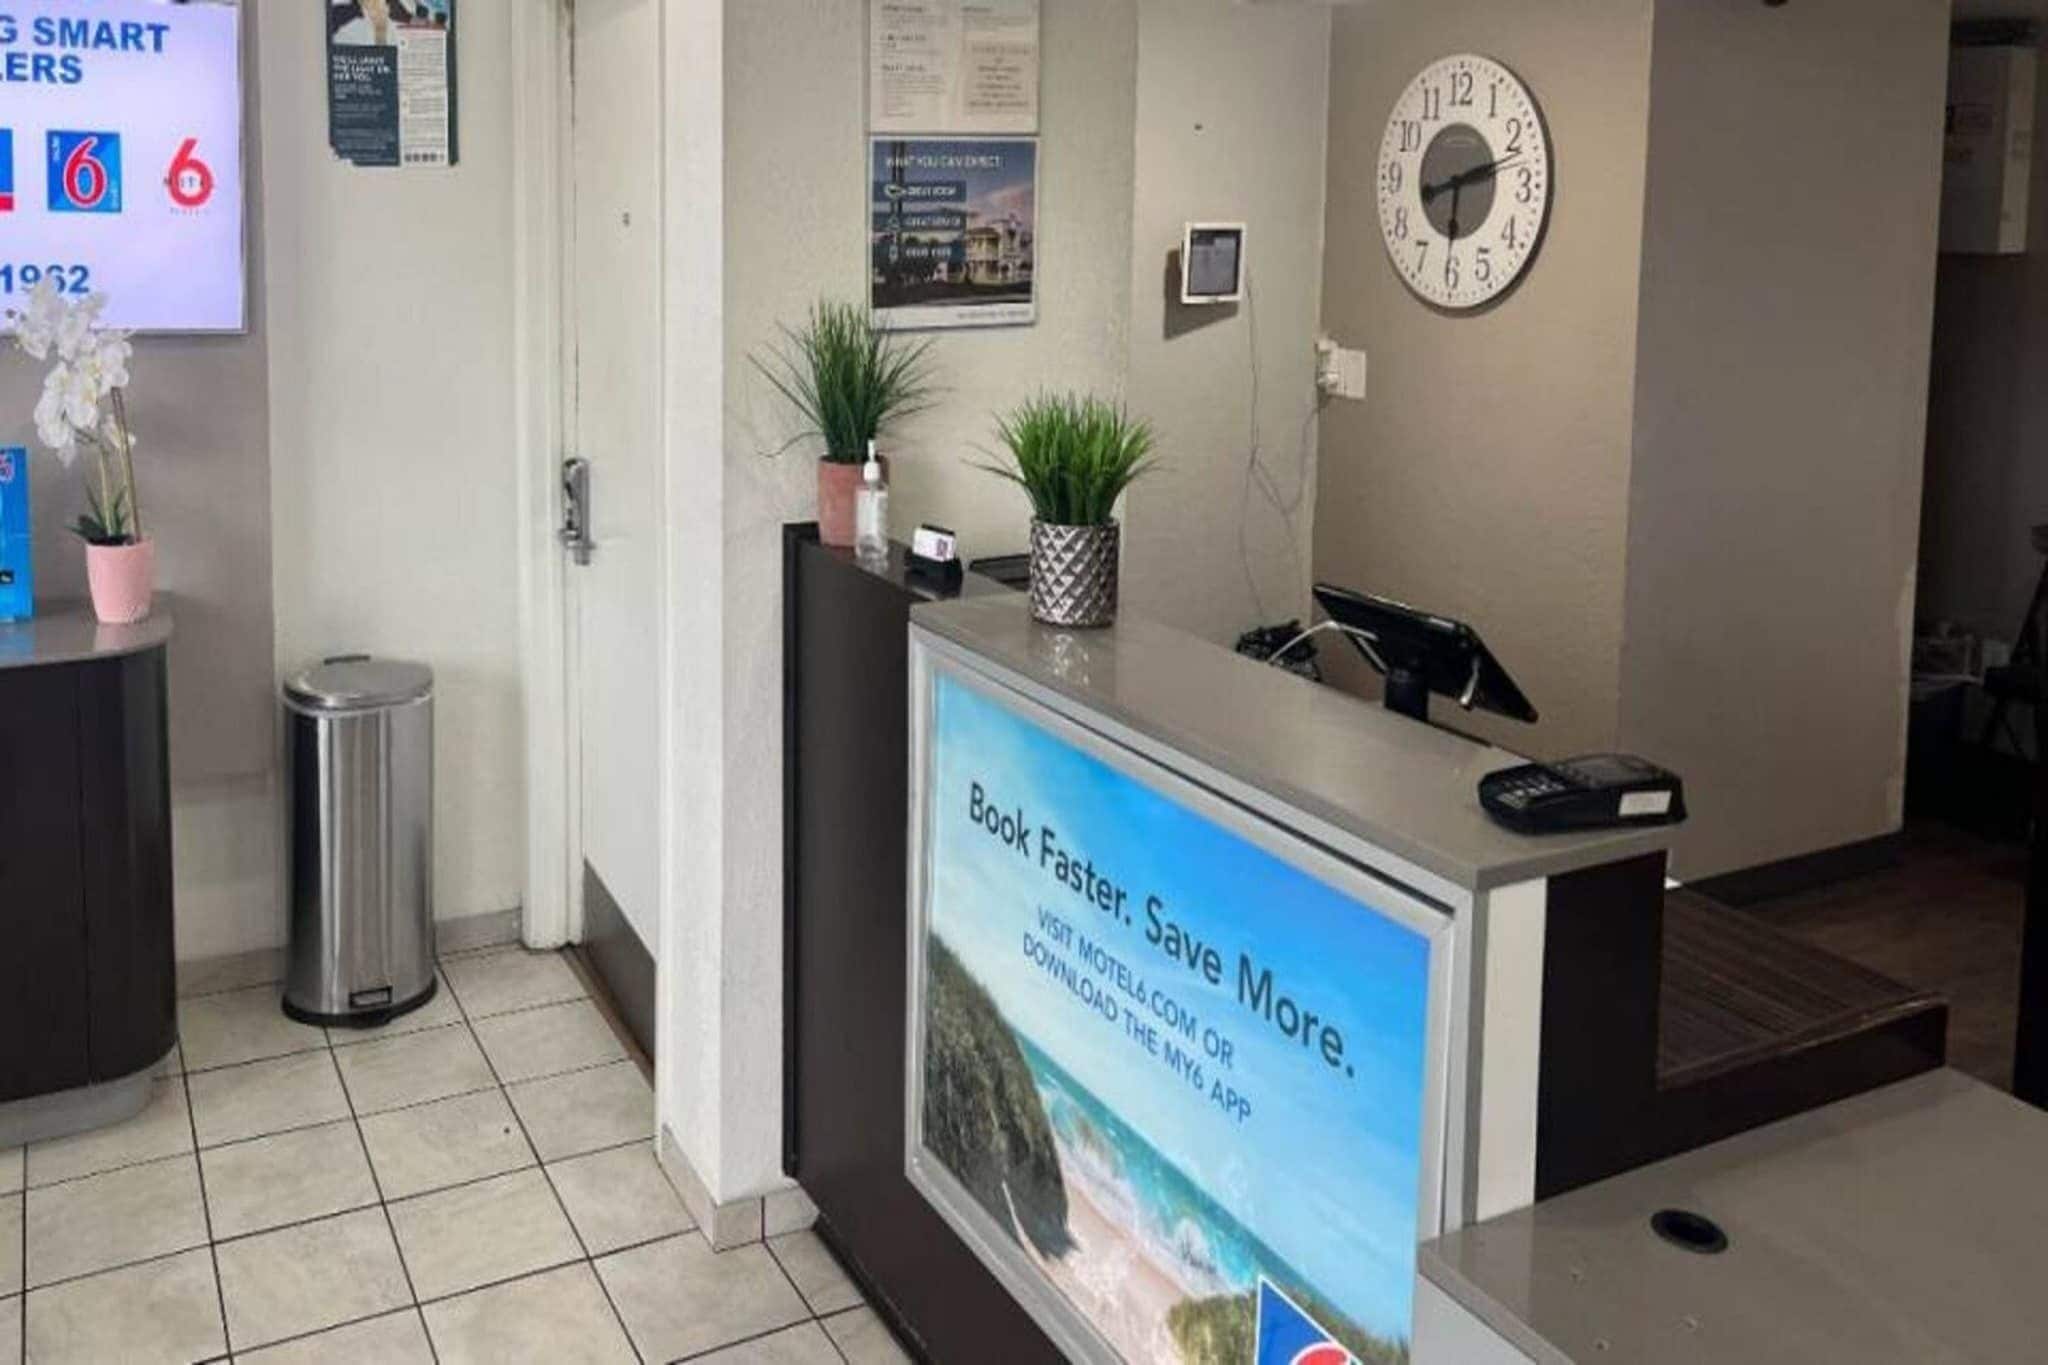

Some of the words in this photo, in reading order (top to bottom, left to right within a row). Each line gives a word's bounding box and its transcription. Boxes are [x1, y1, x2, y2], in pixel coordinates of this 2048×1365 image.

[33, 16, 170, 52] SMART
[0, 52, 83, 84] ERS
[1422, 86, 1441, 120] 11
[1449, 71, 1474, 106] 12
[1487, 83, 1497, 118] 1
[1400, 120, 1422, 152] 10
[1505, 117, 1523, 152] 2
[64, 136, 107, 206] 6
[167, 138, 214, 207] 6
[1389, 161, 1401, 194] 9
[1515, 168, 1532, 203] 3
[1394, 208, 1408, 239] 8
[1501, 215, 1516, 249] 4
[1415, 240, 1429, 272] 7
[1445, 254, 1460, 289] 6
[1475, 247, 1490, 281] 5
[0, 264, 90, 294] 1962
[968, 782, 1030, 856] Book
[1039, 826, 1132, 926] Faster.
[1145, 895, 1223, 986] Save
[1238, 953, 1356, 1078] More.
[1037, 904, 1073, 950] VISIT
[1078, 937, 1198, 1044] MOTEL6.COM
[1204, 1029, 1235, 1068] OR
[1023, 931, 1119, 1023] DOWNLOAD
[1124, 1010, 1158, 1057] THE
[1163, 1040, 1203, 1091] MY6
[1209, 1080, 1252, 1124] APP
